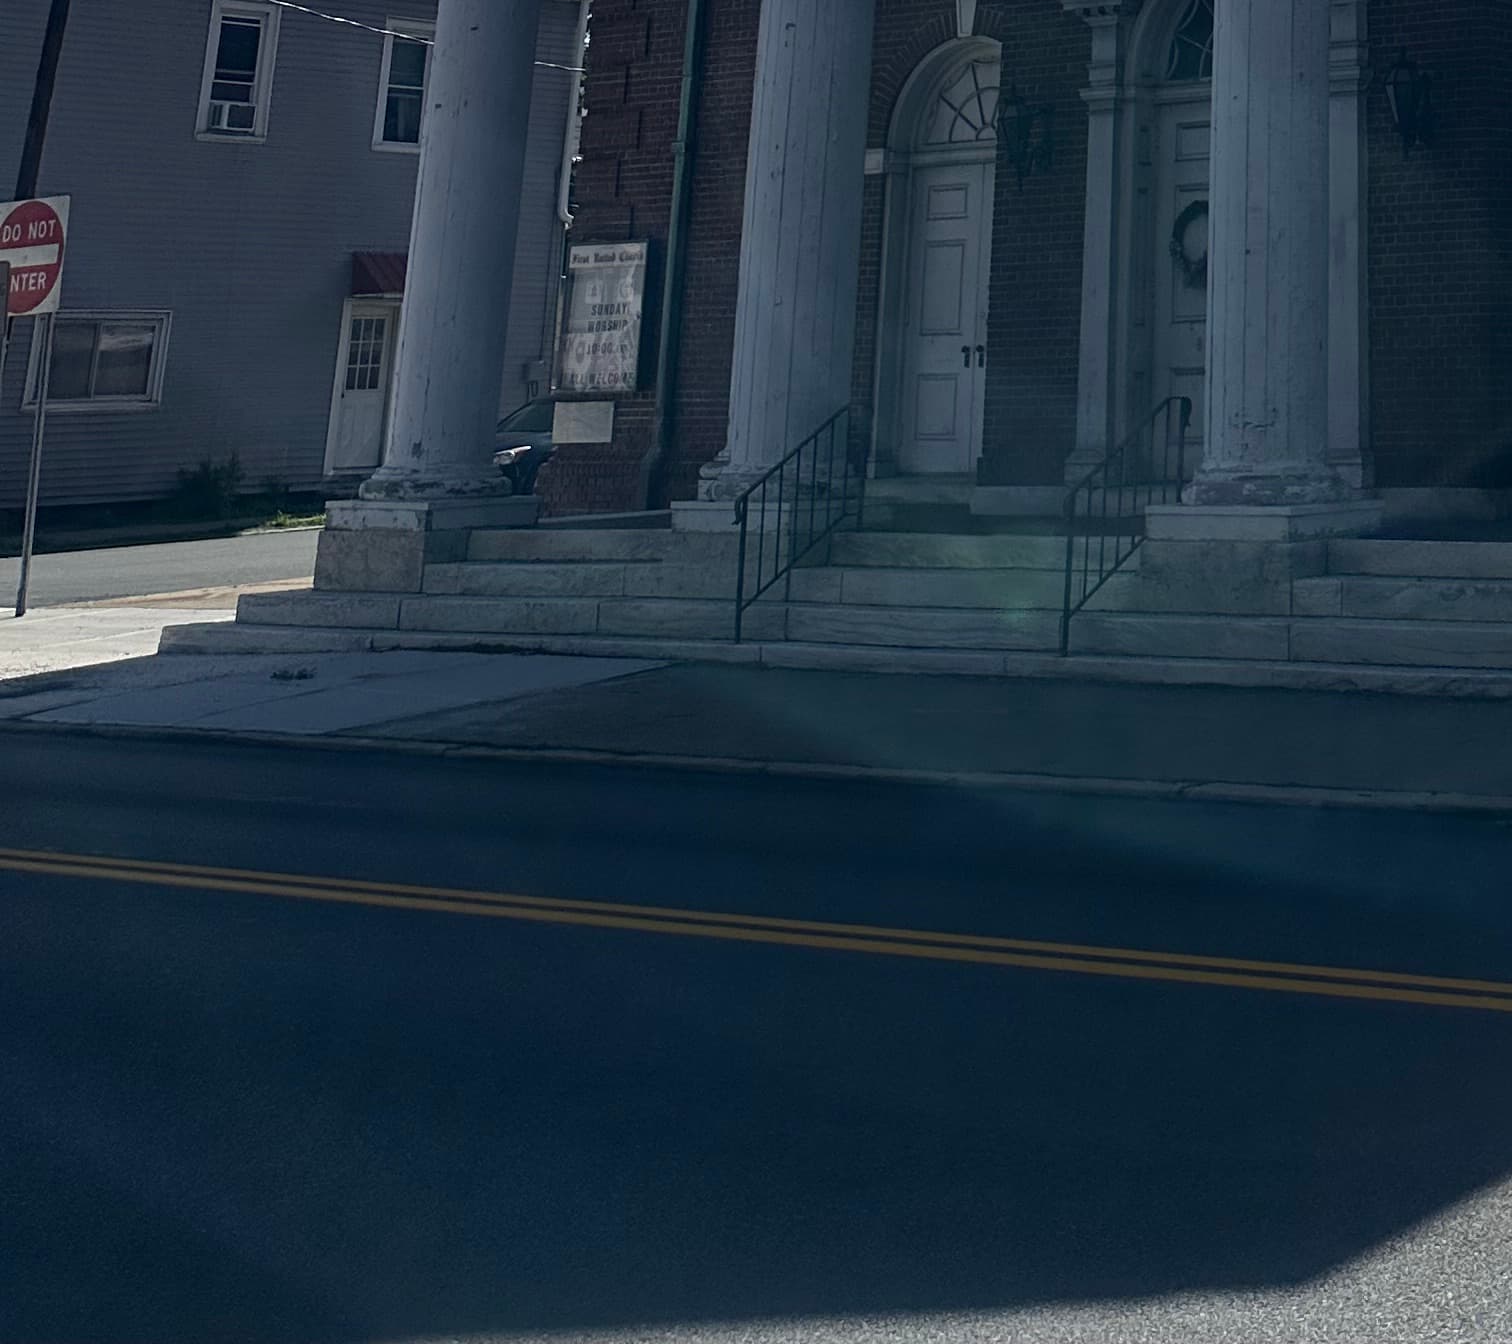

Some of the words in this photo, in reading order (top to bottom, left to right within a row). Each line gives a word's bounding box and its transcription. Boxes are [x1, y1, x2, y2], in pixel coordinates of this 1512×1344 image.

[2, 224, 21, 243] DO
[28, 219, 56, 240] NOT
[9, 271, 47, 293] NTER
[591, 303, 627, 316] SUNDAY
[587, 319, 628, 333] WORSHIP
